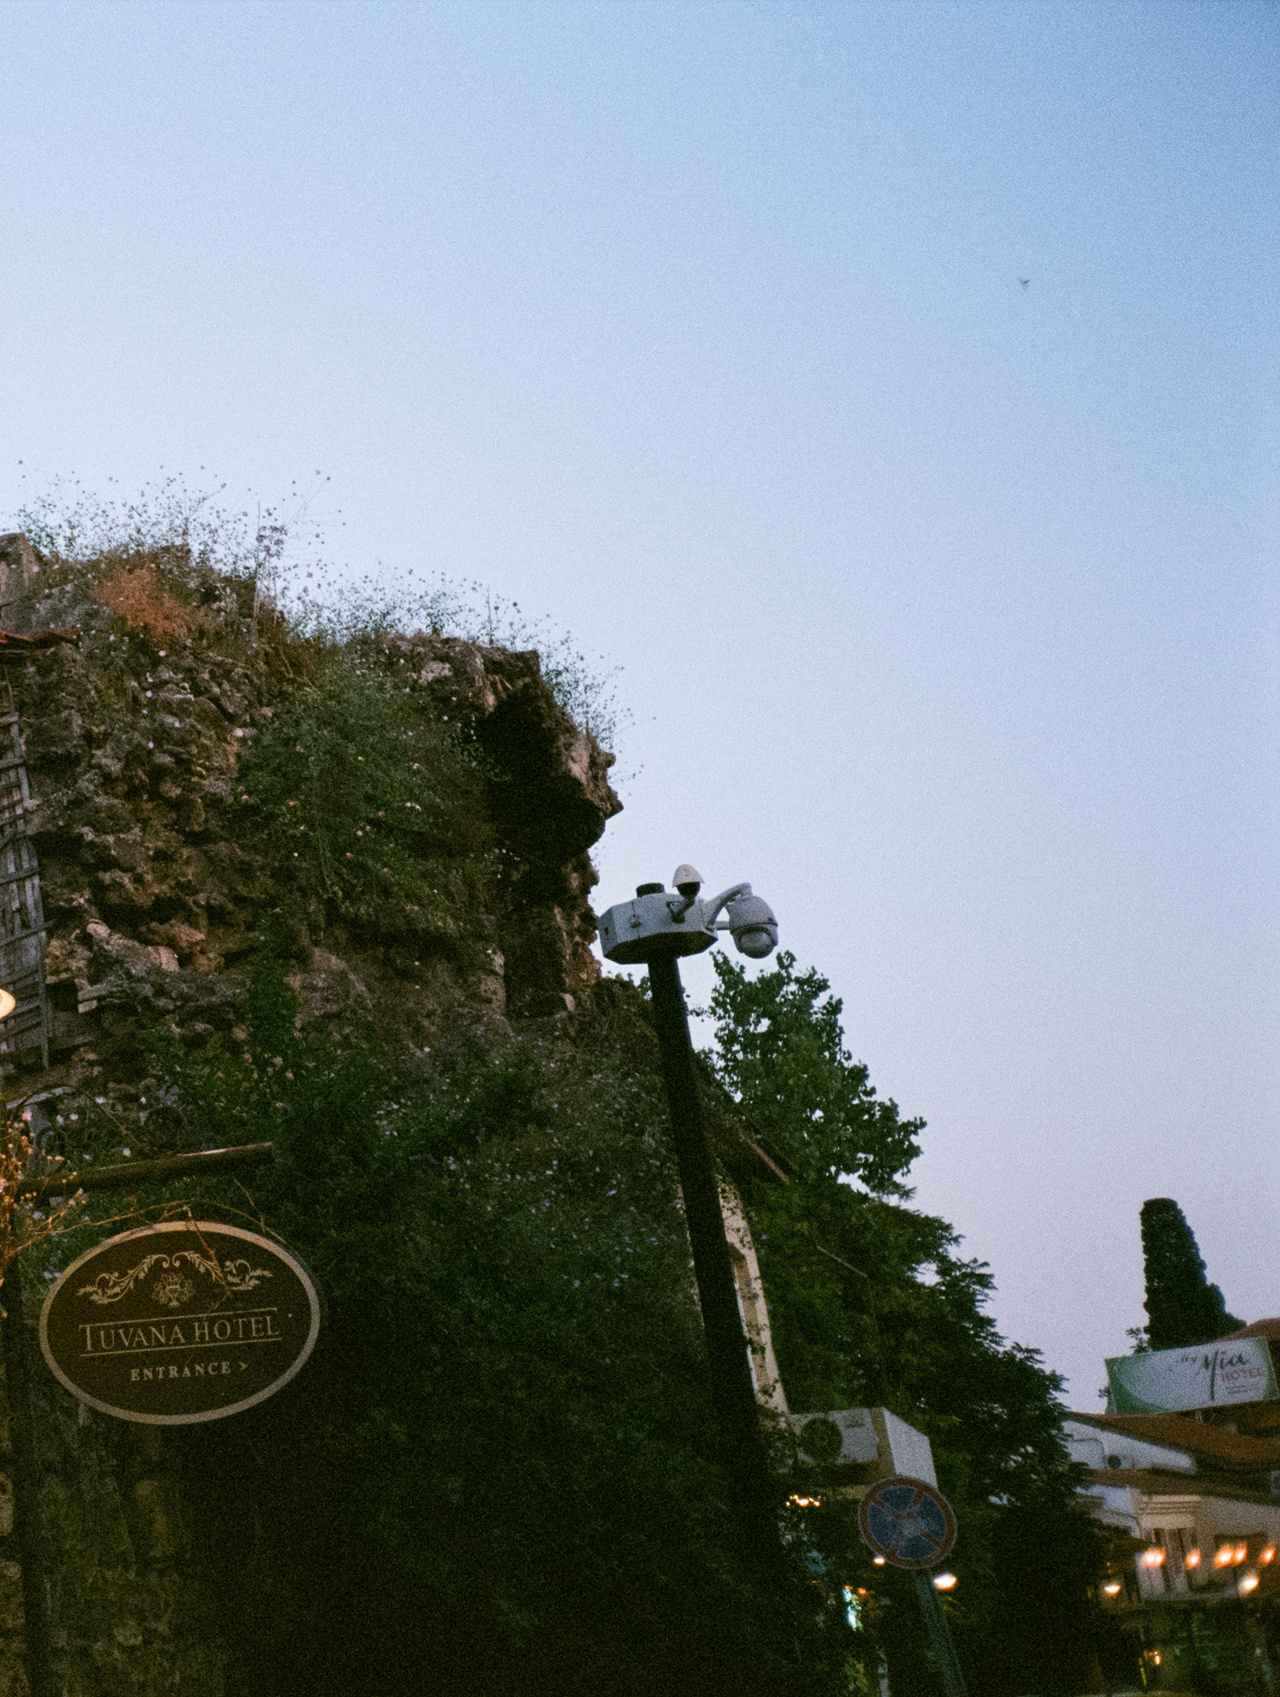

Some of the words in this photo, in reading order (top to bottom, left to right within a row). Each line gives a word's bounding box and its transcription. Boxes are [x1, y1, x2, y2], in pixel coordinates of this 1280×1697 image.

[79, 1324, 186, 1351] TUVANA
[194, 1315, 280, 1342] HOTEL
[131, 1361, 231, 1382] ENTRANCE
[1220, 1367, 1265, 1382] HOTEL
